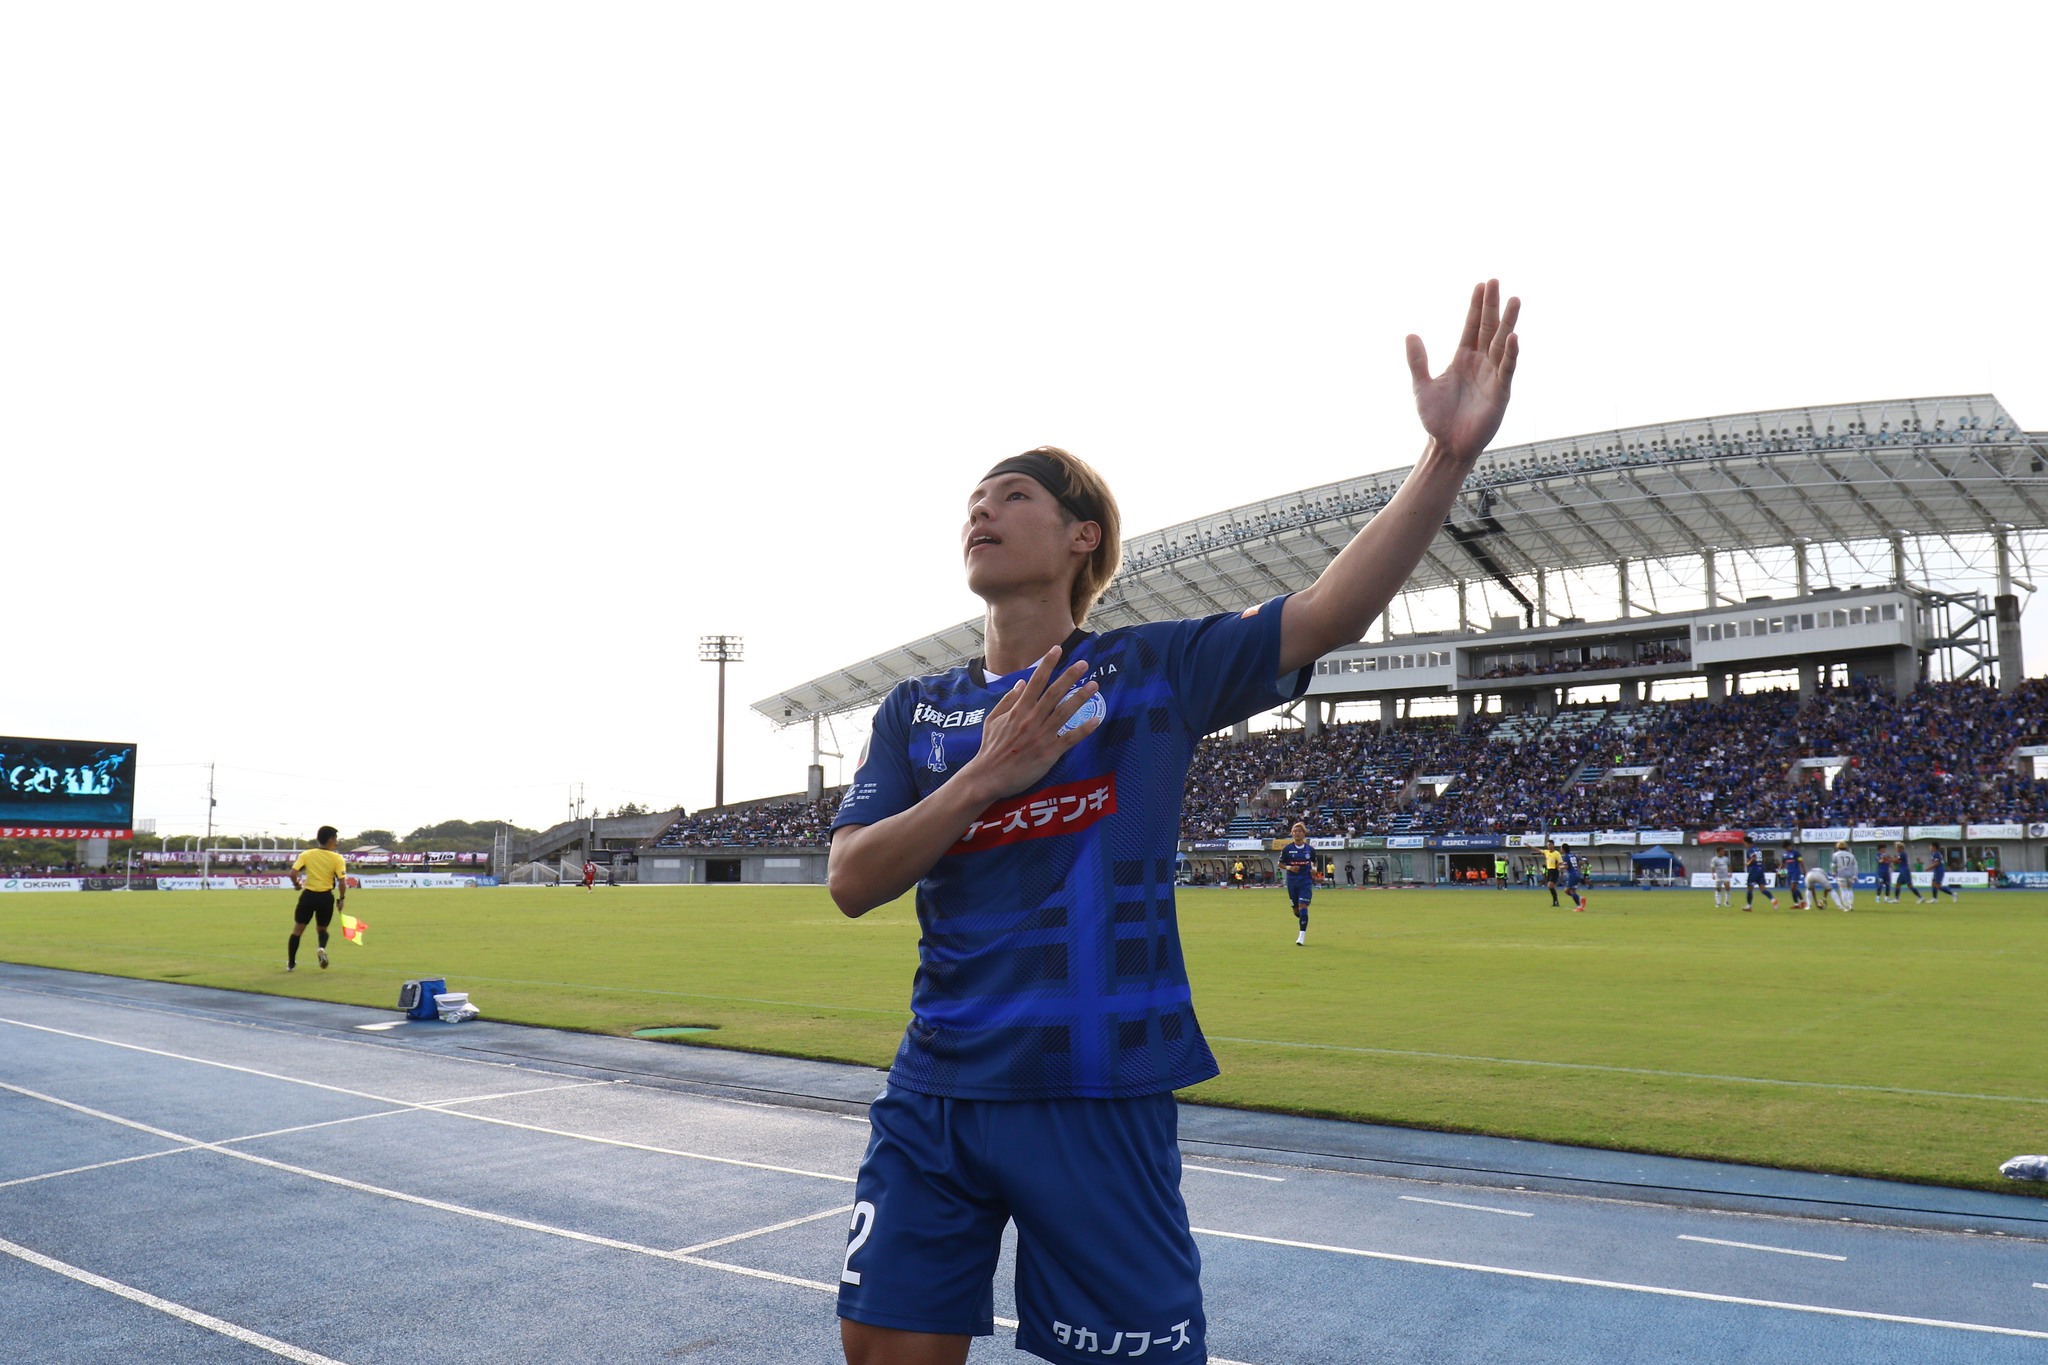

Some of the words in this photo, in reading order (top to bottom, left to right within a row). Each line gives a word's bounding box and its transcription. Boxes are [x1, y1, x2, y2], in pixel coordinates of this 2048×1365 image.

[3, 828, 124, 838] デンキスタジアム水戸
[1840, 856, 1852, 867] 17
[22, 881, 71, 889] OKAWA
[234, 877, 281, 886] ISUZU
[841, 1200, 876, 1286] 2
[1052, 1319, 1191, 1358] タカノフーズ
